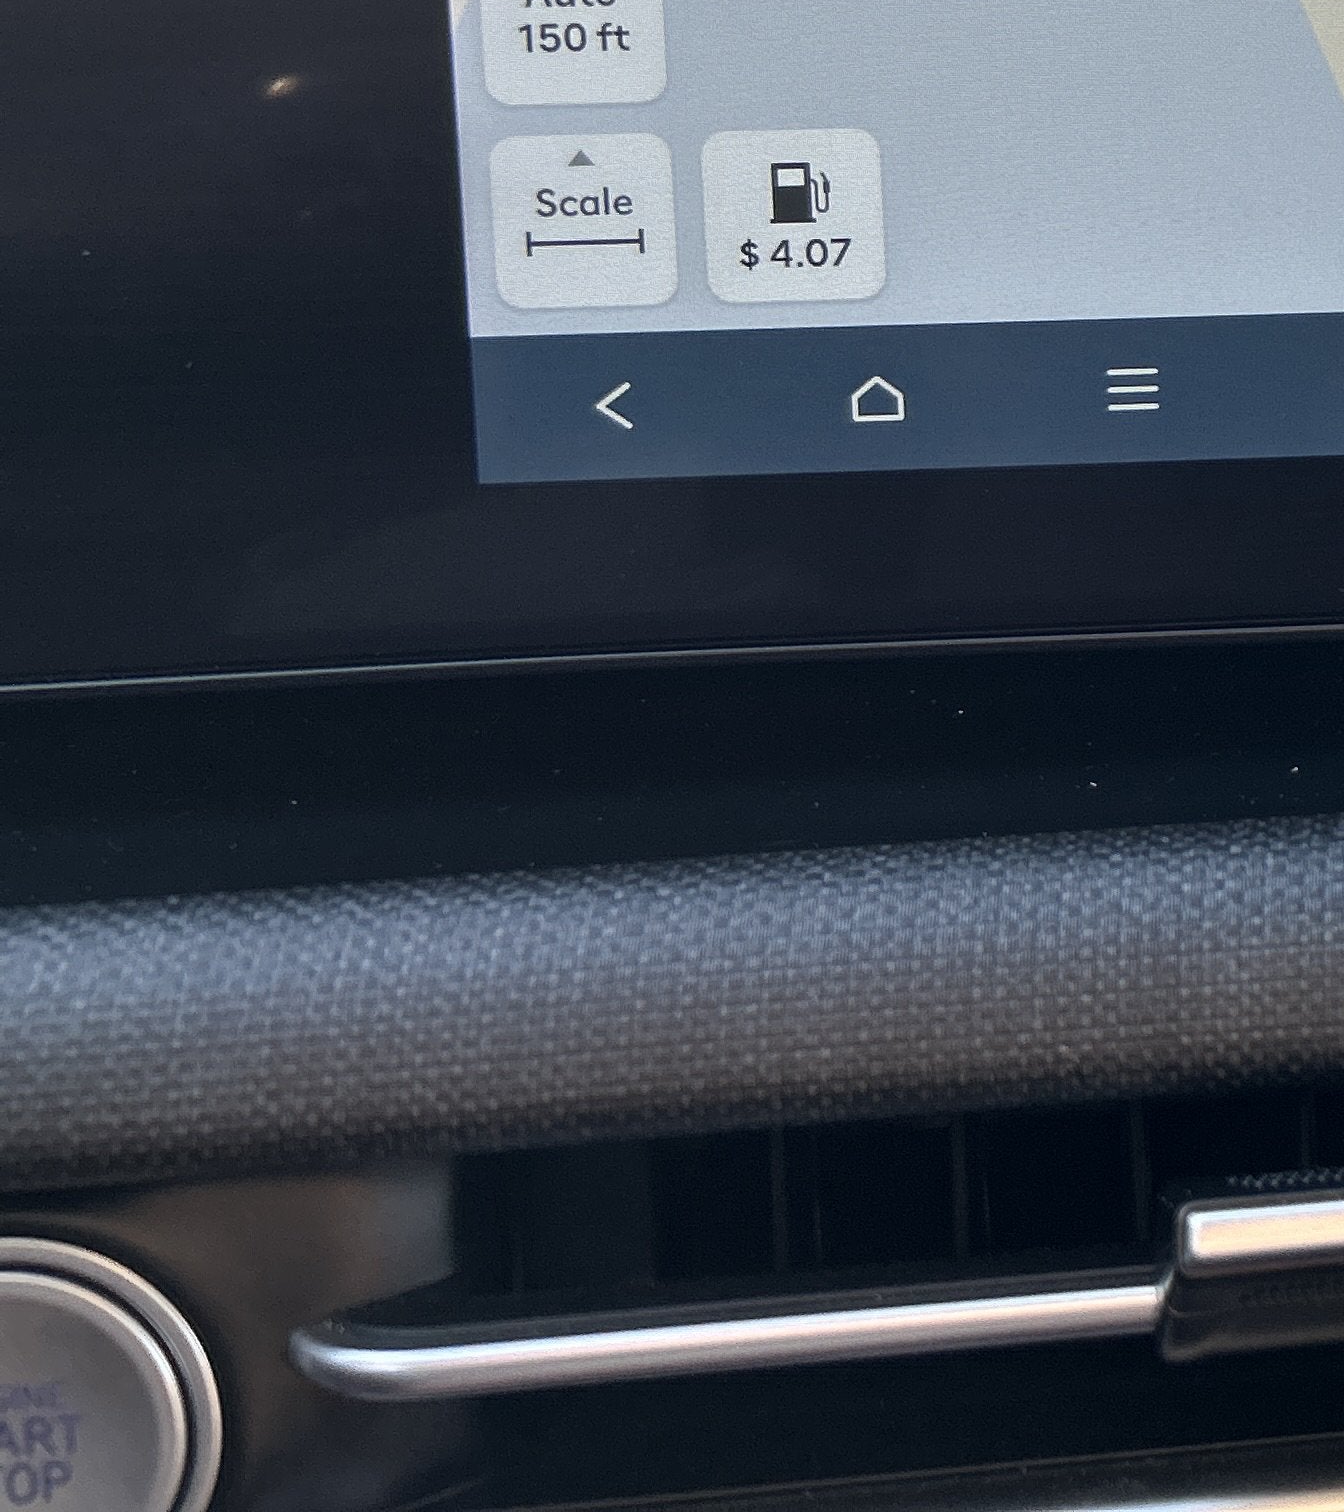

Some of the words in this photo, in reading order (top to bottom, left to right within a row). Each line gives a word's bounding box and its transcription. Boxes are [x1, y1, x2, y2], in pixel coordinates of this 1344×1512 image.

[518, 23, 588, 53] 150
[596, 22, 631, 52] ft
[535, 187, 634, 218] Scale
[739, 239, 761, 271] $
[771, 237, 852, 268] 4.07
